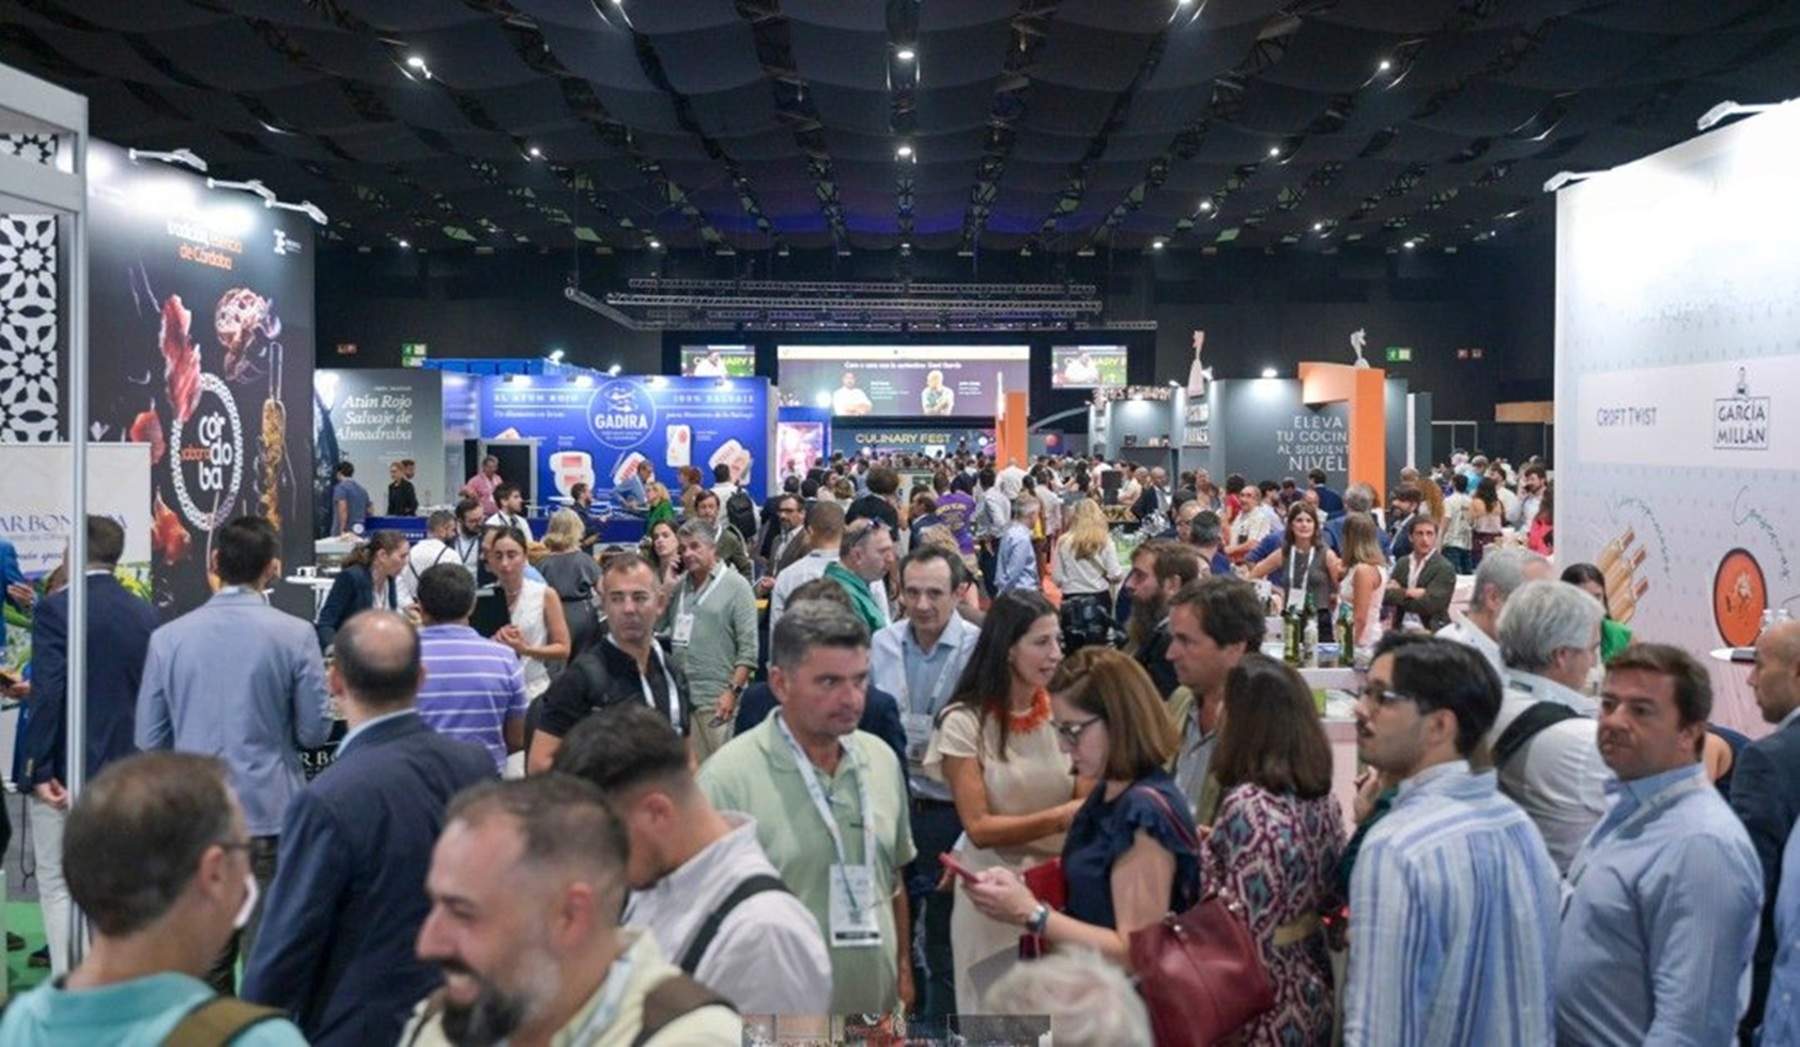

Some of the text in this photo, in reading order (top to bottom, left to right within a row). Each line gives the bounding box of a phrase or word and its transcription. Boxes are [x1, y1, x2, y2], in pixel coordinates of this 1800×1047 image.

[381, 394, 413, 412] Rojo
[395, 410, 413, 424] de
[1718, 402, 1766, 421] GARCÍA
[594, 414, 649, 430] GADIRA
[1294, 416, 1343, 429] ELEVA
[856, 433, 951, 443] CULINARY FEST
[1276, 431, 1347, 442] TU COCIN
[1277, 445, 1350, 455] AL SIGUIENT
[1289, 455, 1347, 472] NIVEL
